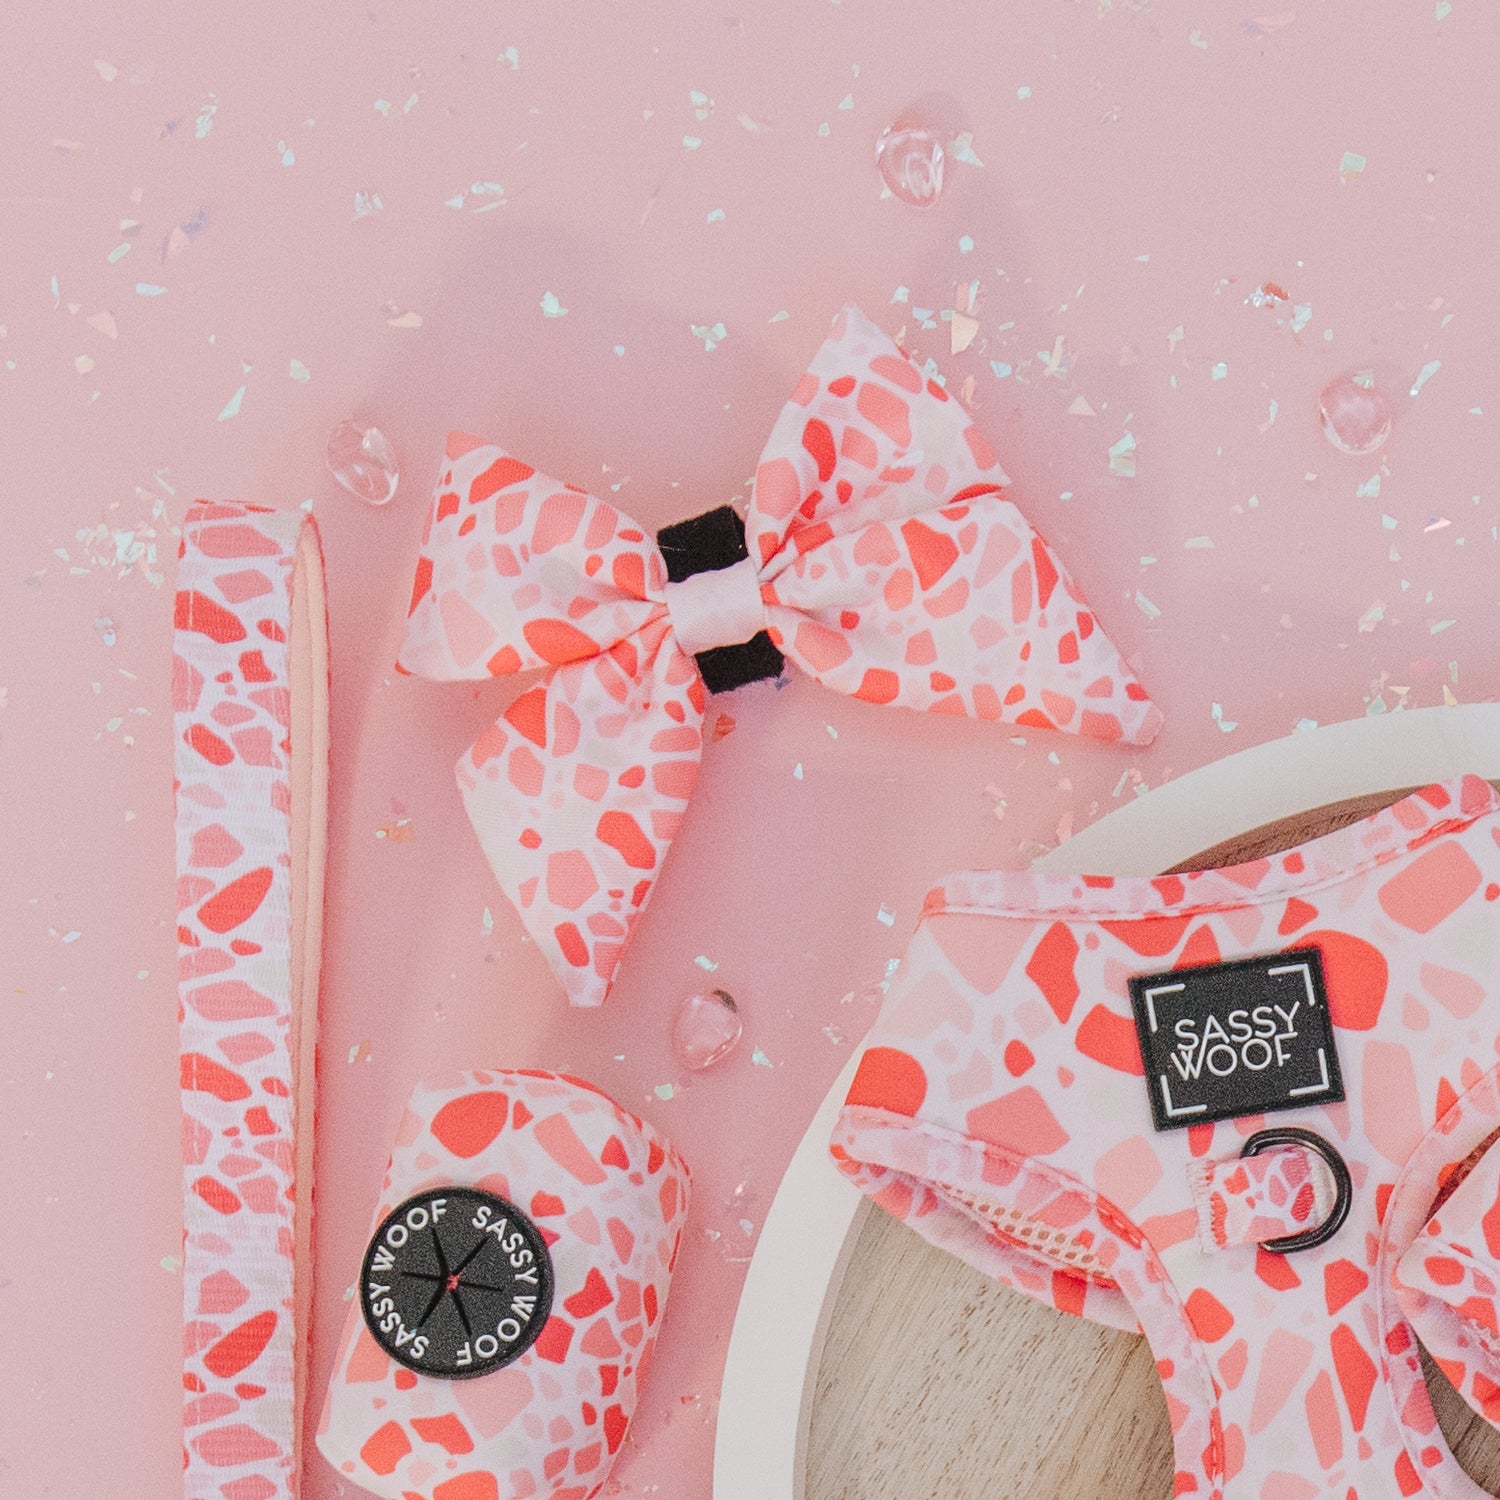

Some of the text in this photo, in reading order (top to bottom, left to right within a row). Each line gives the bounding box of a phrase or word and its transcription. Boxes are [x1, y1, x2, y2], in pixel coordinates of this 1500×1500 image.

[1170, 1031, 1298, 1081] WOOF
[1174, 1001, 1300, 1051] SASSY
[369, 1199, 447, 1360] SASSY WOOF
[456, 1205, 539, 1367] SASSY WOOF
